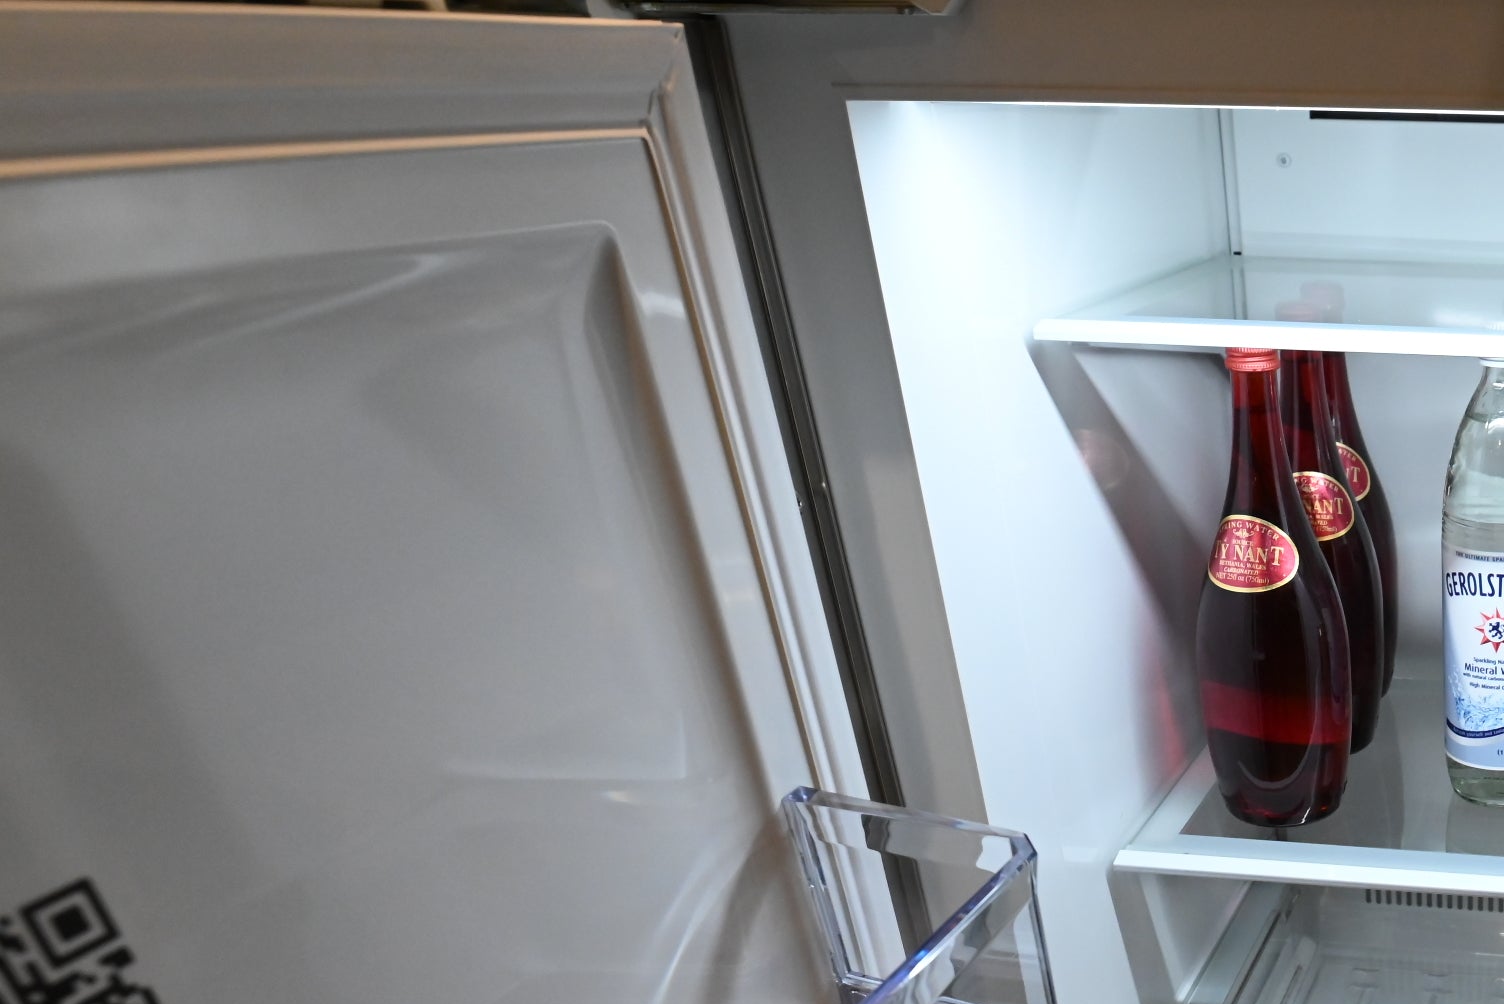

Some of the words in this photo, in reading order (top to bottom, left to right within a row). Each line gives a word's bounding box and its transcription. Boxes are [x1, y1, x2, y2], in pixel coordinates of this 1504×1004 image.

[1245, 521, 1280, 541] WATER
[1233, 544, 1285, 567] NANT
[1465, 553, 1490, 562] ULTIMATE
[1473, 657, 1497, 666] Sparkling
[1464, 663, 1498, 676] Mineral
